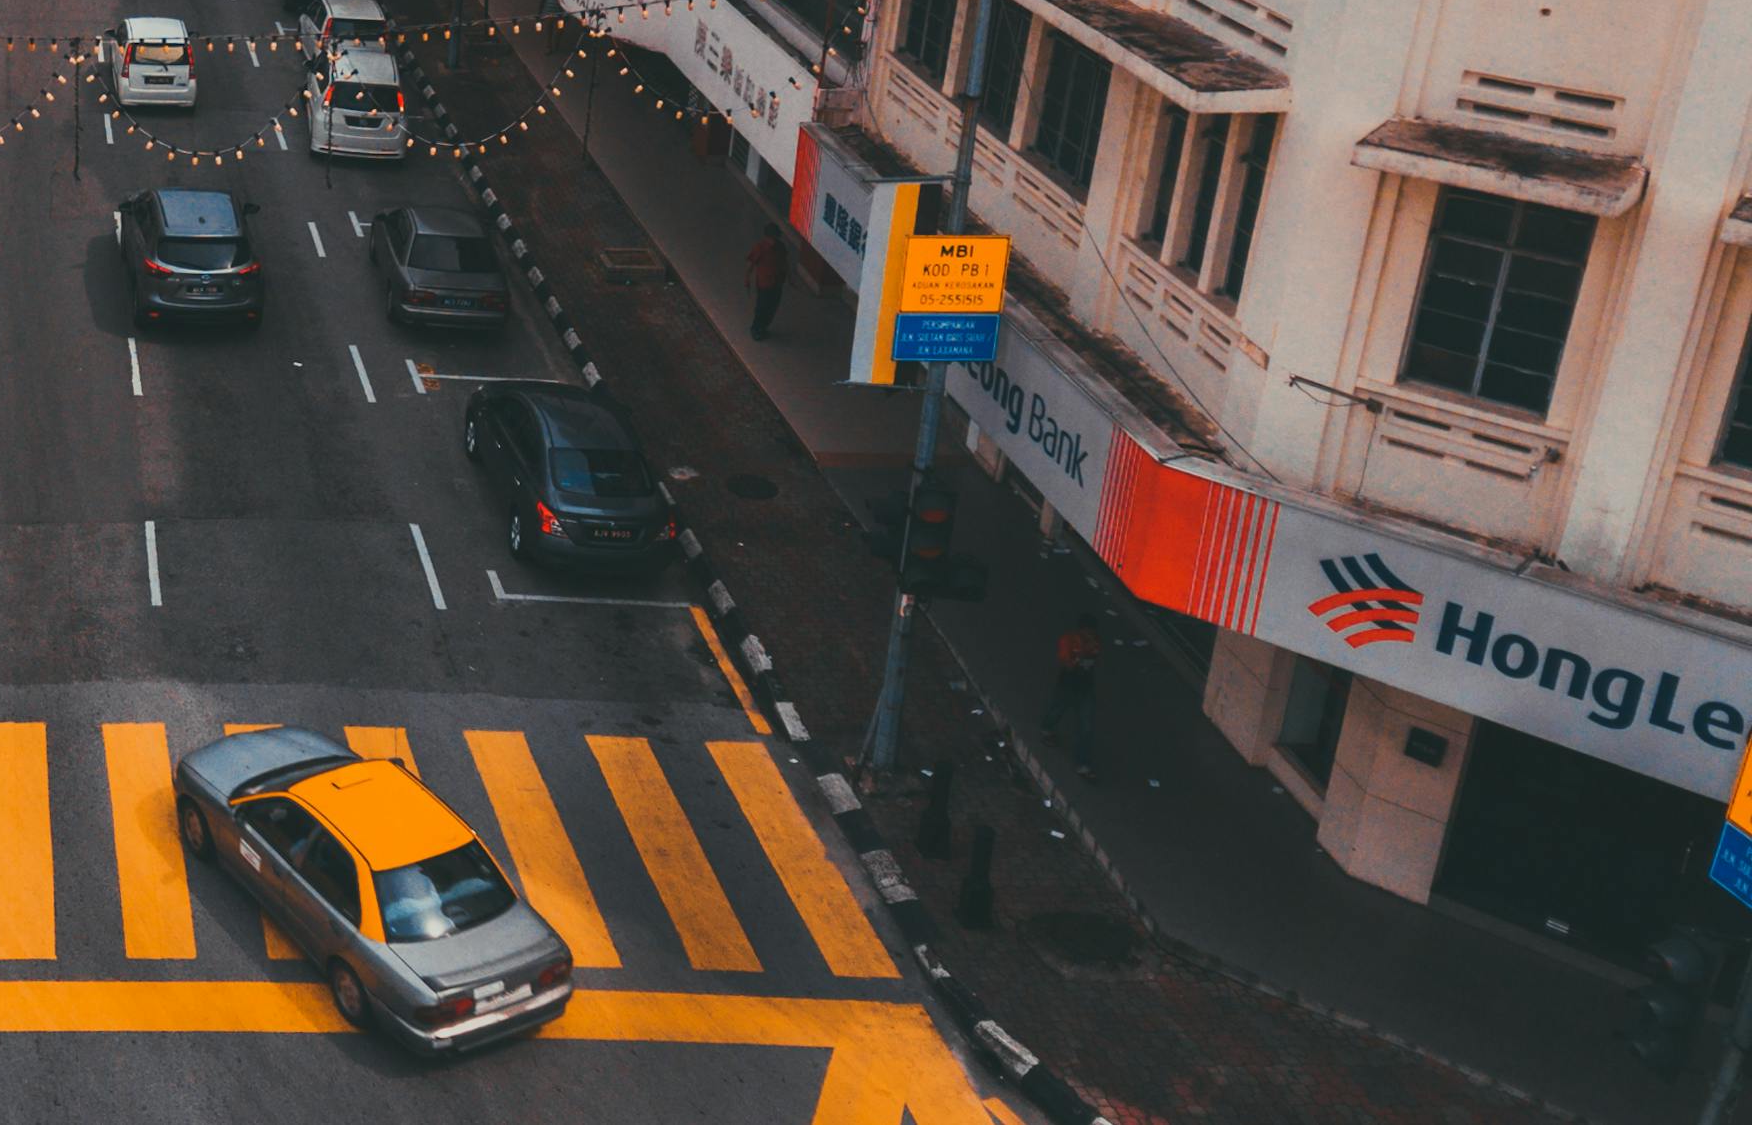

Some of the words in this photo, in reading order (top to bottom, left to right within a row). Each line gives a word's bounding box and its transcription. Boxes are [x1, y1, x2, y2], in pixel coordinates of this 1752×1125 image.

[940, 245, 974, 258] MBI
[923, 264, 950, 276] KOD
[920, 295, 984, 305] 05-2551515
[1029, 393, 1089, 489] Bank
